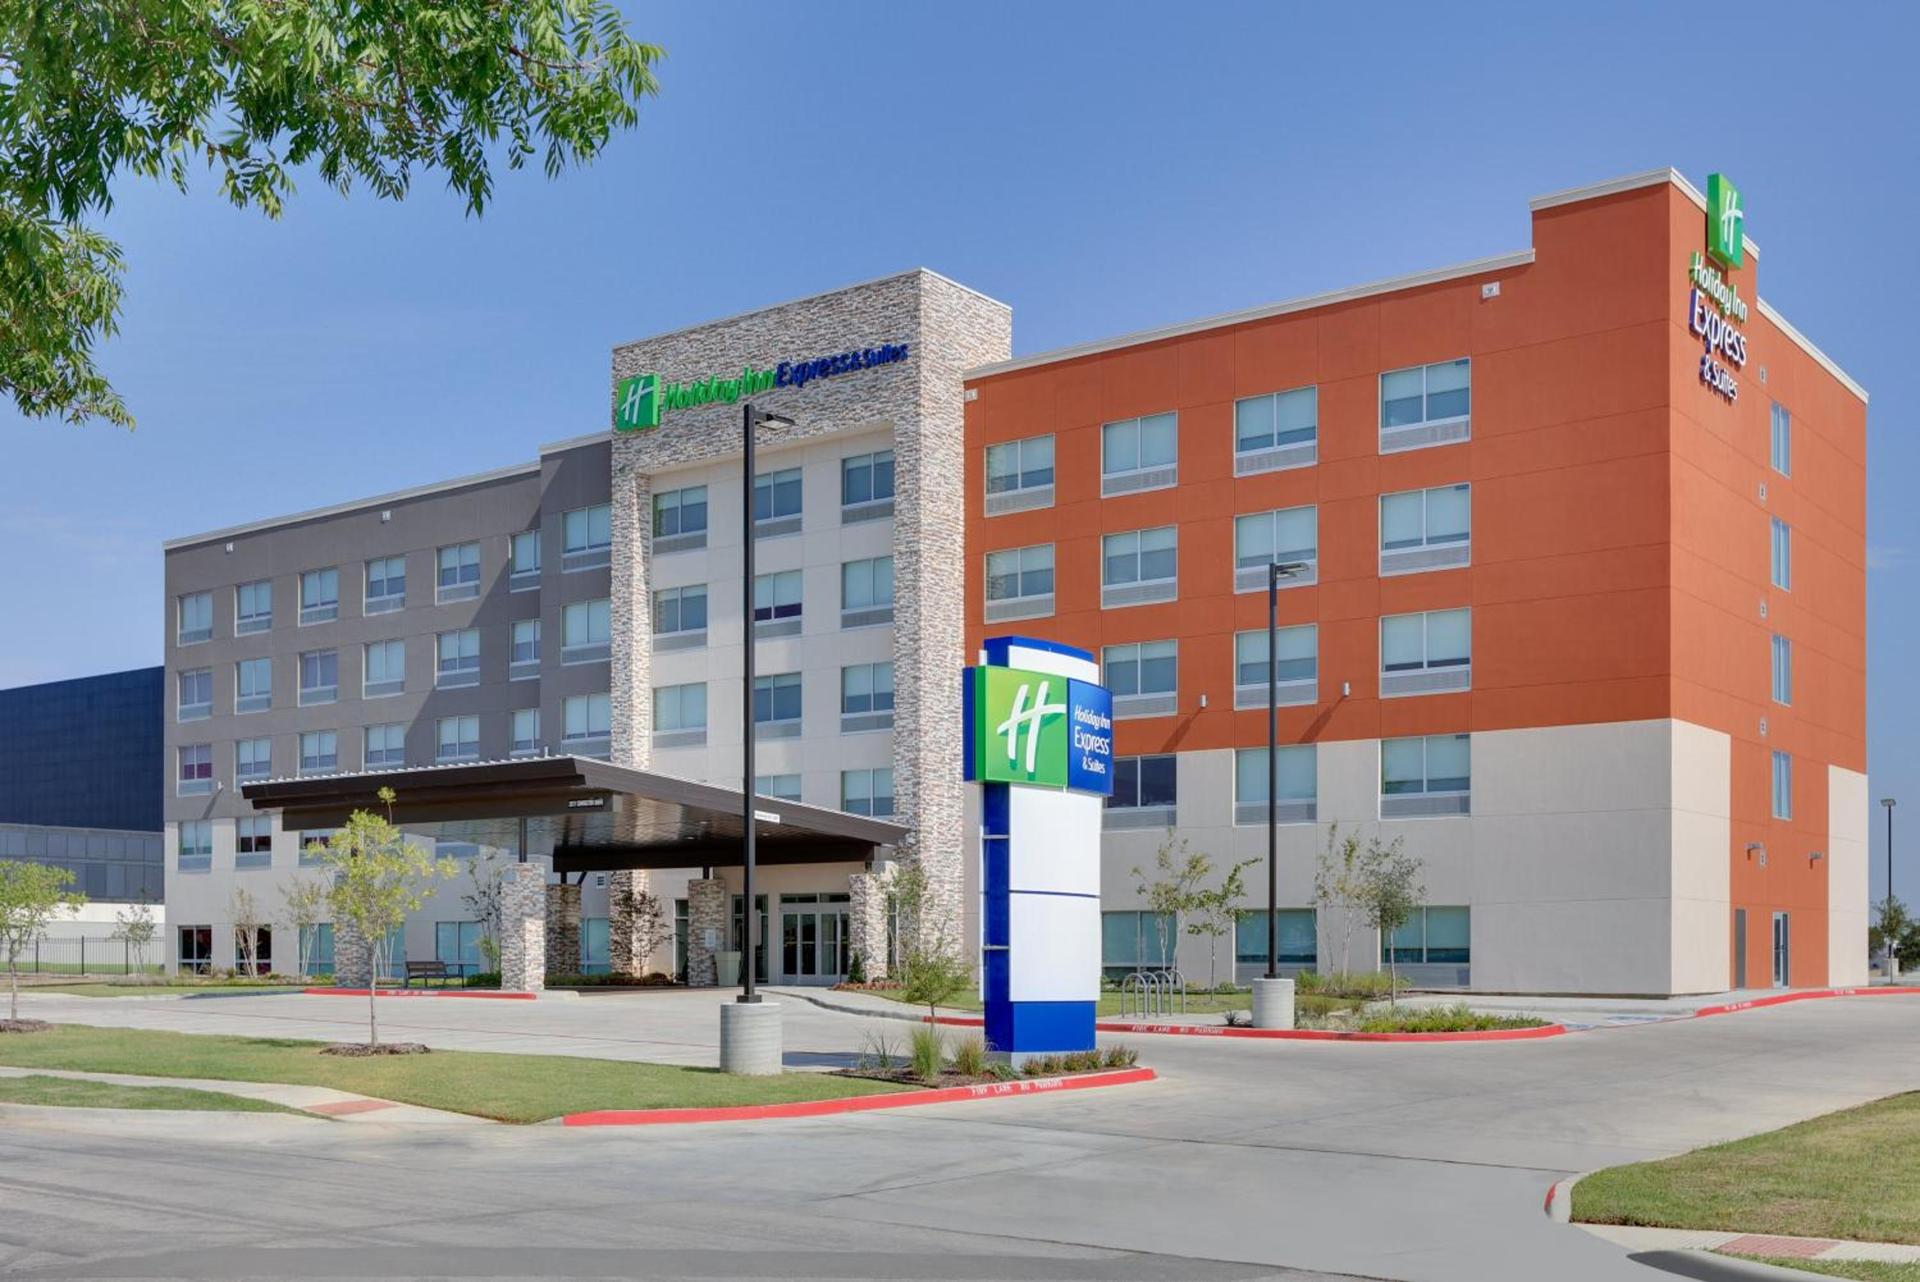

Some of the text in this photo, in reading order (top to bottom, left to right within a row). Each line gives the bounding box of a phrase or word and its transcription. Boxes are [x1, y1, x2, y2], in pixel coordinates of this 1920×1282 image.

[1690, 252, 1748, 323] Holiday Inn
[1691, 288, 1748, 367] Express
[663, 373, 740, 411] Holiday
[742, 366, 776, 395] Inn
[775, 352, 850, 388] Express
[1701, 354, 1739, 400] & Suites
[997, 680, 1067, 773] H
[1074, 703, 1111, 730] Holiday Inn
[1074, 725, 1110, 756] Express
[1087, 757, 1106, 774] Suites
